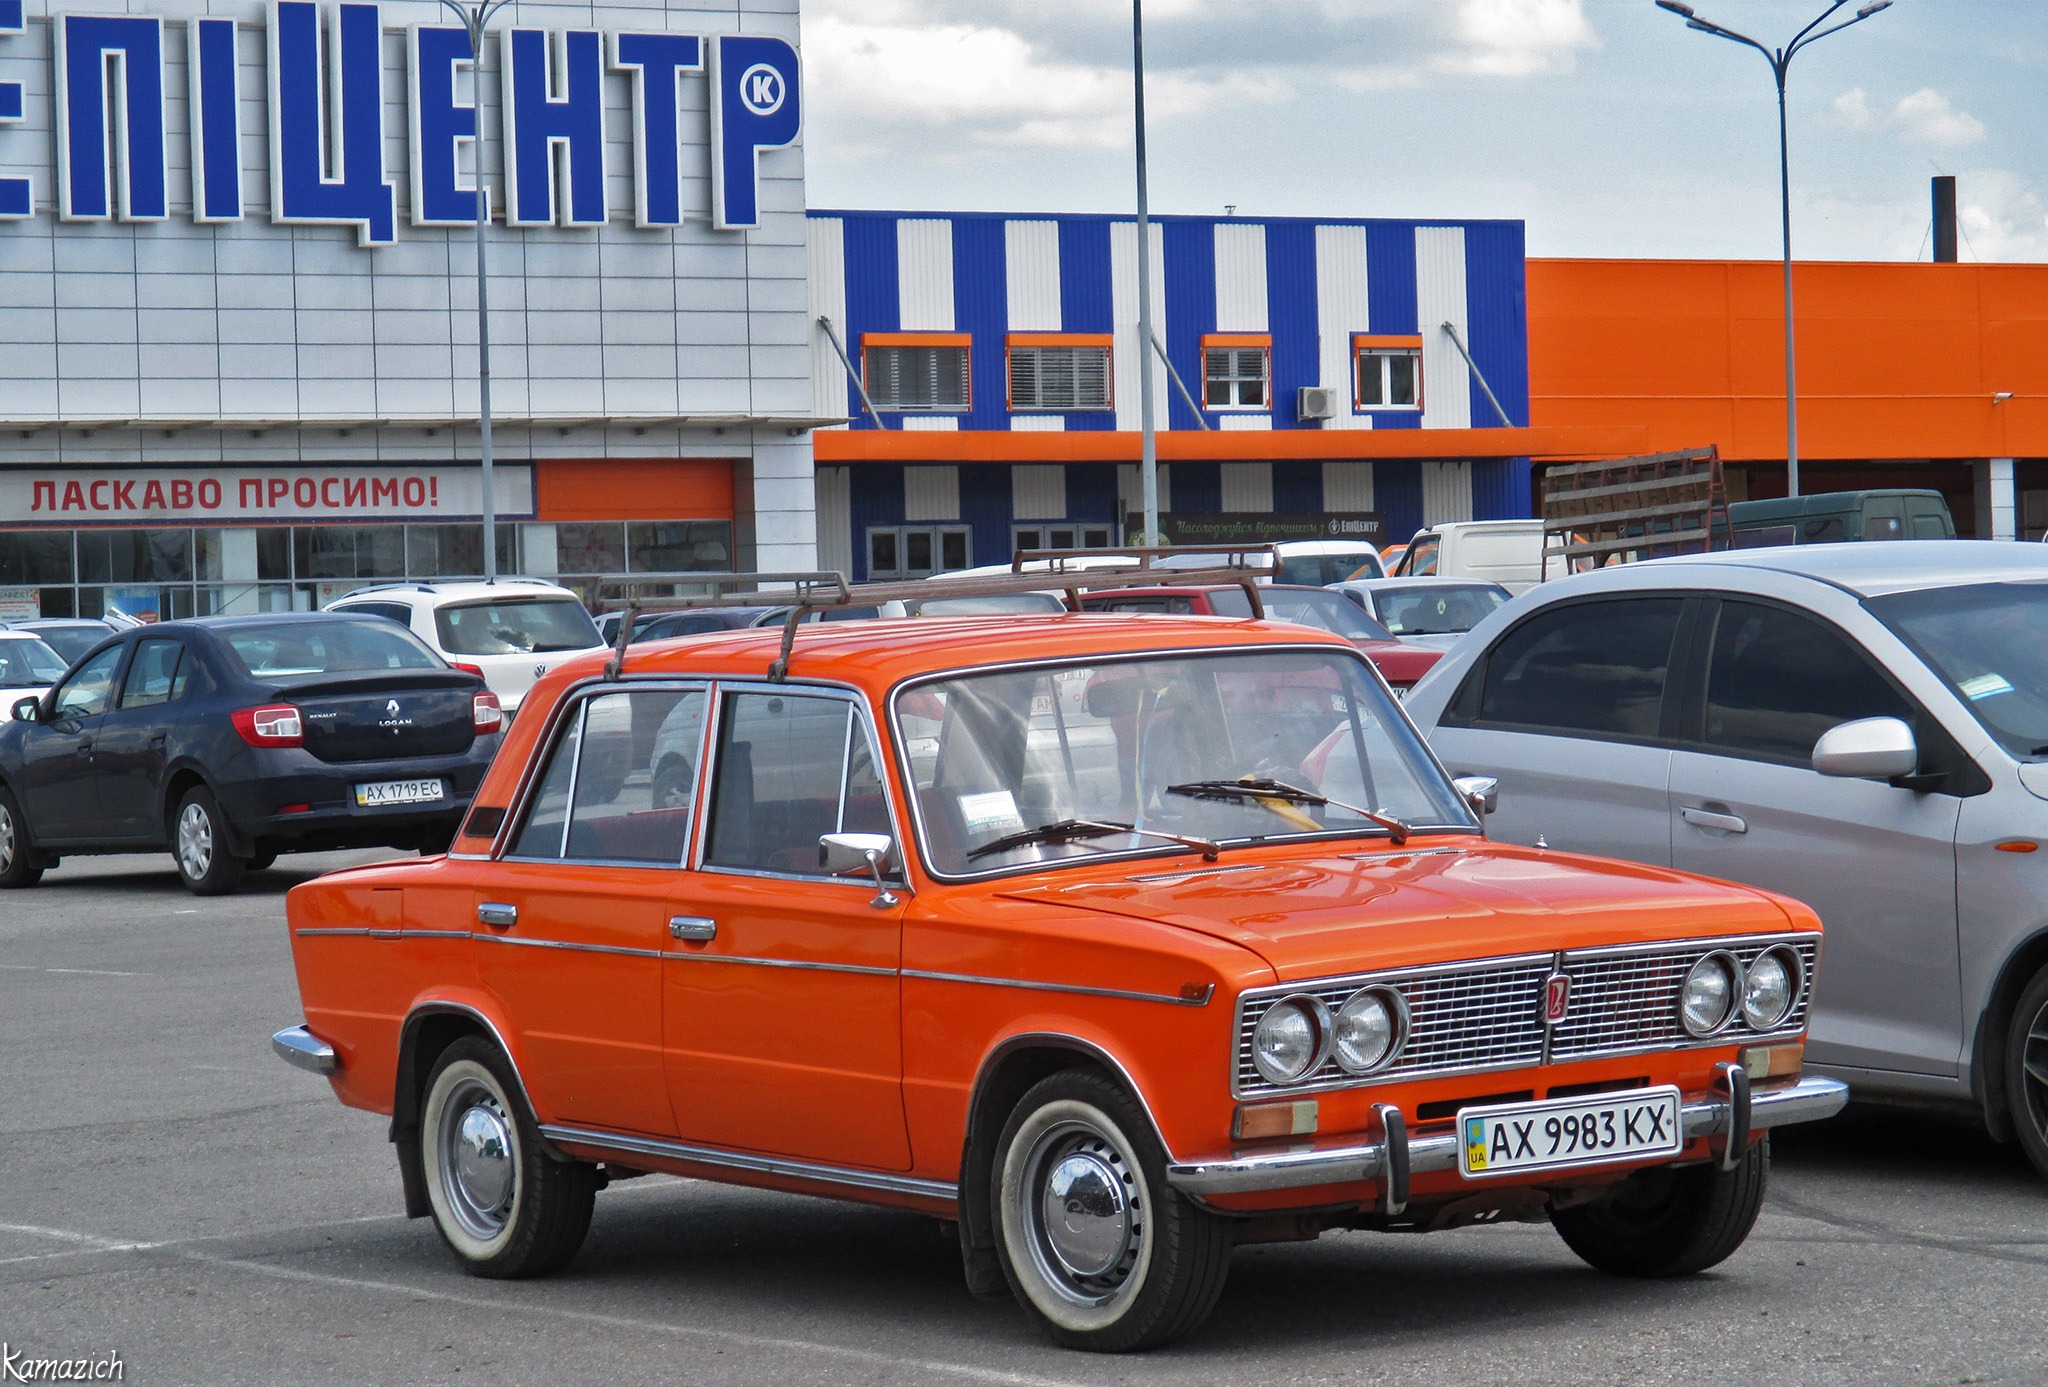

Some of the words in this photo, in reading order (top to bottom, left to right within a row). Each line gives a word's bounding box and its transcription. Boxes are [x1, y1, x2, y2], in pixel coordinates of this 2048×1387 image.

[31, 479, 223, 512] ЛАСКАВО
[238, 475, 438, 508] ПРОСИМО!
[1176, 520, 1252, 541] Насолоджуйся
[1256, 520, 1318, 540] відпочинком
[366, 785, 386, 801] AX
[389, 782, 418, 798] 1719
[420, 781, 440, 796] EC
[1490, 1119, 1536, 1162] AX
[1545, 1110, 1616, 1155] 9983
[1624, 1103, 1668, 1146] KX
[1470, 1152, 1485, 1164] UA
